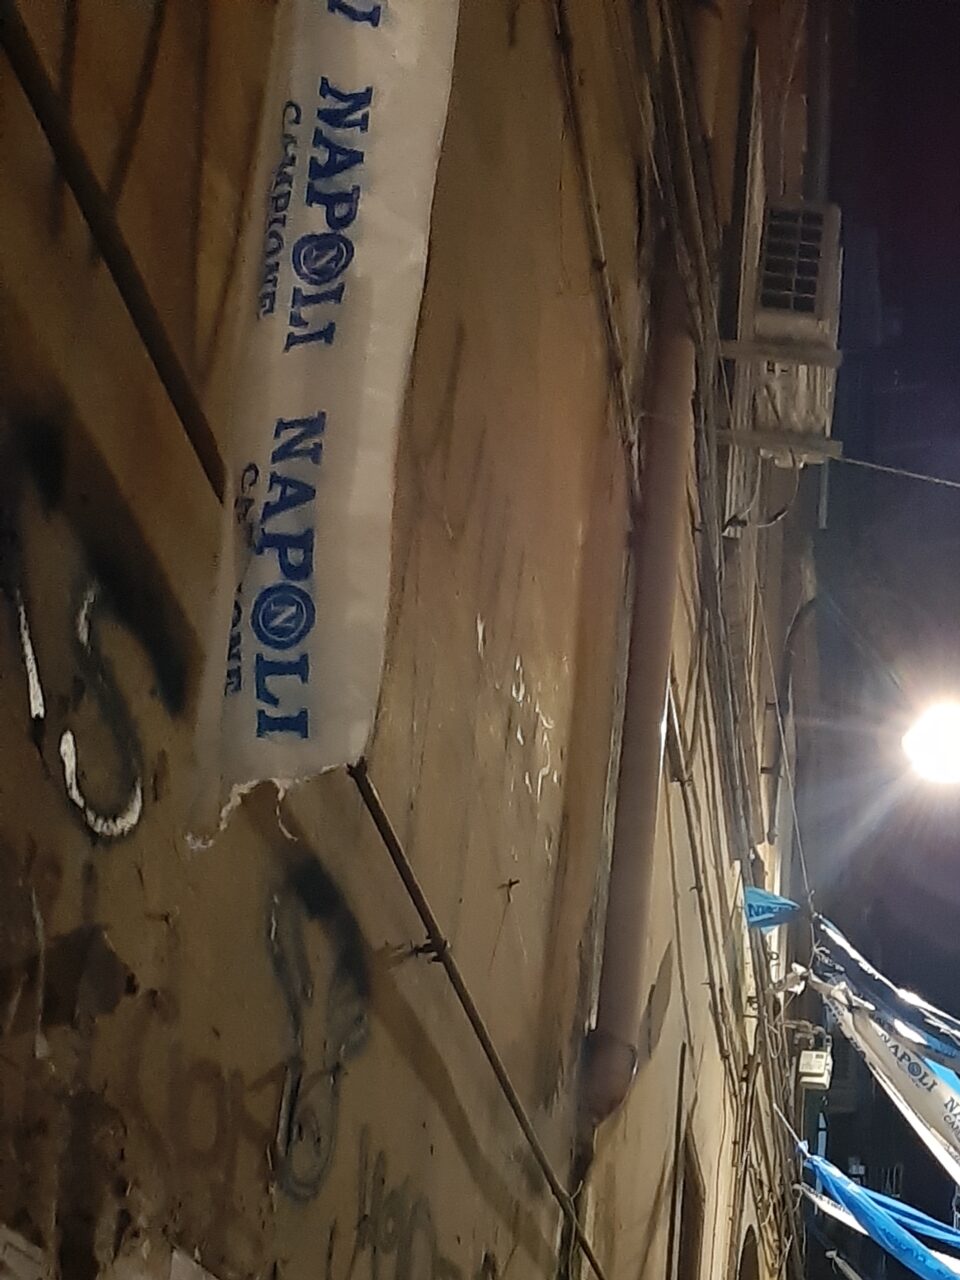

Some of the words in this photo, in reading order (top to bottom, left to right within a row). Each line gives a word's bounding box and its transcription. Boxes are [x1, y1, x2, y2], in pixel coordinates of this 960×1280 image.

[283, 76, 374, 353] NAPOLI
[250, 410, 327, 739] NAPOLI
[880, 1033, 938, 1092] NAPOLI
